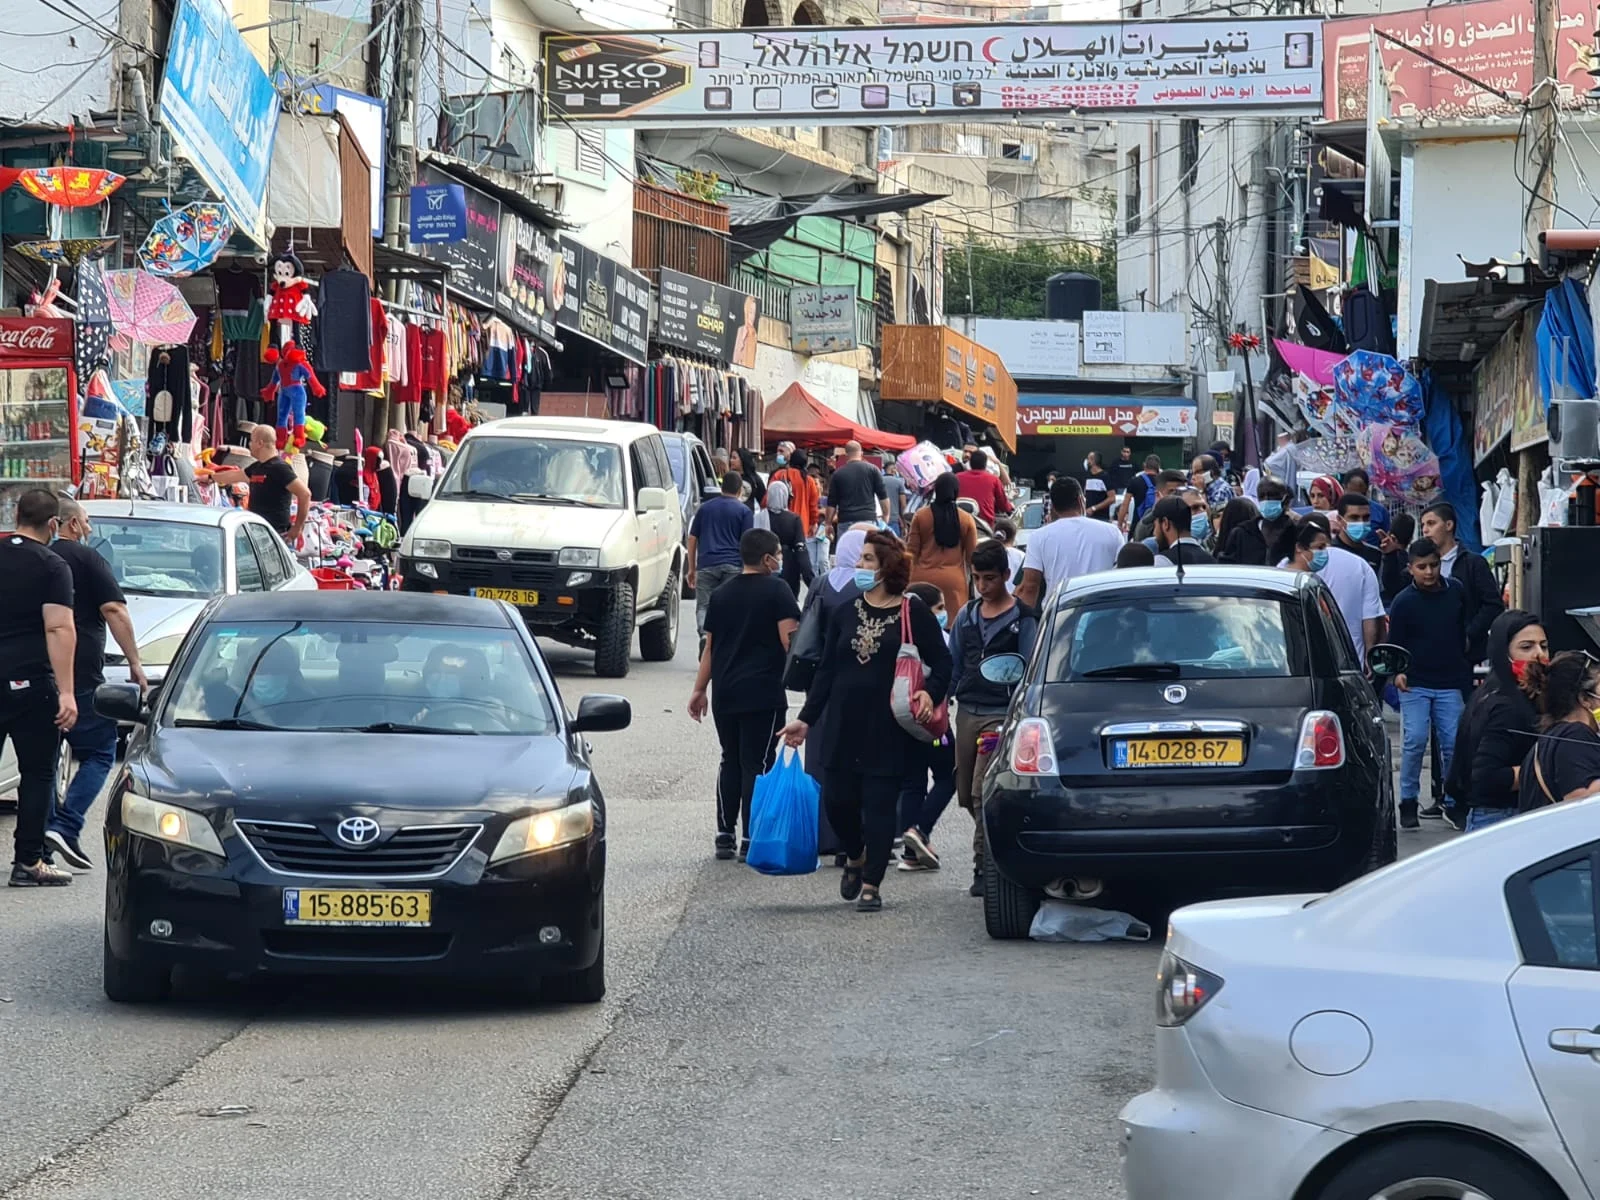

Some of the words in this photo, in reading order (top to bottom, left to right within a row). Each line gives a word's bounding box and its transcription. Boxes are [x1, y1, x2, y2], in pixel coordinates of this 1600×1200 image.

[1459, 13, 1522, 48] الصدق
[753, 38, 872, 66] אלהלאל
[884, 37, 973, 64] חשמל
[1011, 34, 1115, 62] الهلال
[1121, 31, 1249, 59] تنويرات
[555, 63, 667, 79] NISKO
[709, 73, 745, 86] ביותר
[884, 69, 934, 82] החשמל
[938, 68, 962, 81] סוגי
[966, 66, 992, 80] לכל
[1005, 62, 1061, 82] الحديثة
[749, 72, 821, 88] המתקדמת
[1209, 85, 1235, 99] هلال
[818, 291, 849, 305] معرض
[1022, 408, 1067, 425] للدواجن
[1068, 408, 1107, 425] السلام
[1108, 408, 1135, 425] محل
